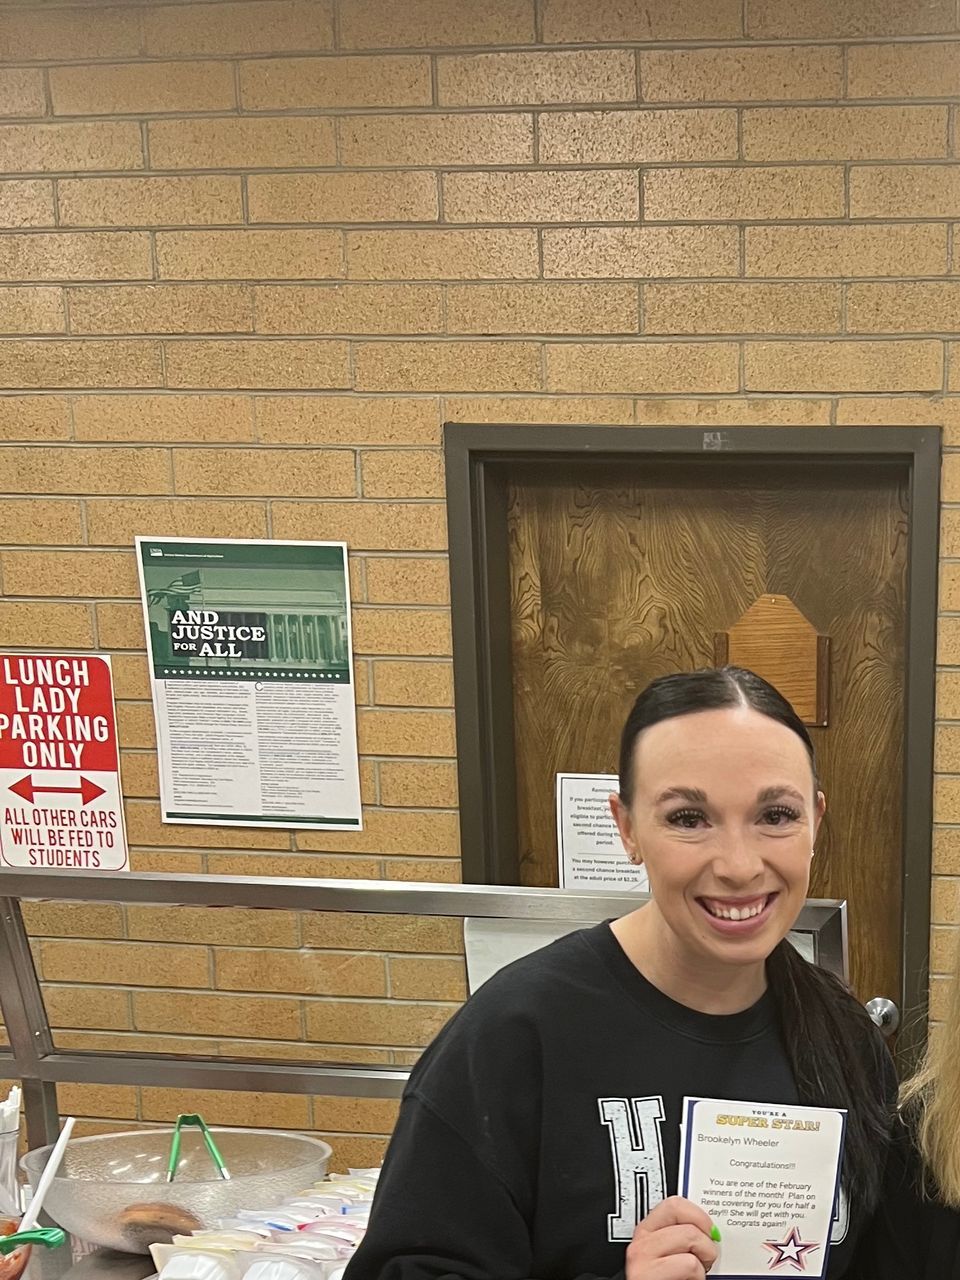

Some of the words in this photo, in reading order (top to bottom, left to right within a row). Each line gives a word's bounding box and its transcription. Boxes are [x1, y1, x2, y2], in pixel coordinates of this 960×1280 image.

[171, 610, 219, 625] AND
[172, 625, 265, 641] JUSTICE
[199, 643, 242, 657] ALL
[4, 658, 89, 686] LUNCH
[15, 686, 81, 714] LADY
[0, 714, 109, 742] PARKING
[22, 742, 84, 768] ONLY
[5, 807, 29, 826] ALL
[33, 808, 77, 827] OTHER
[81, 810, 117, 828] CARS
[11, 828, 44, 846] WILL
[48, 830, 64, 846] BE
[69, 830, 93, 847] FED
[99, 831, 114, 848] TO
[29, 848, 101, 867] STUDENTS
[716, 1114, 768, 1128] SUPER
[771, 1119, 820, 1131] STAR!
[697, 1134, 741, 1146] Brookelyn
[743, 1137, 779, 1147] Wheeler
[710, 1178, 724, 1186] You
[756, 1180, 764, 1188] of
[780, 1182, 811, 1191] February
[722, 1200, 754, 1208] covering
[768, 1201, 781, 1209] you
[795, 1201, 809, 1209] half
[760, 1211, 772, 1219] get
[727, 1219, 760, 1228] Congrats
